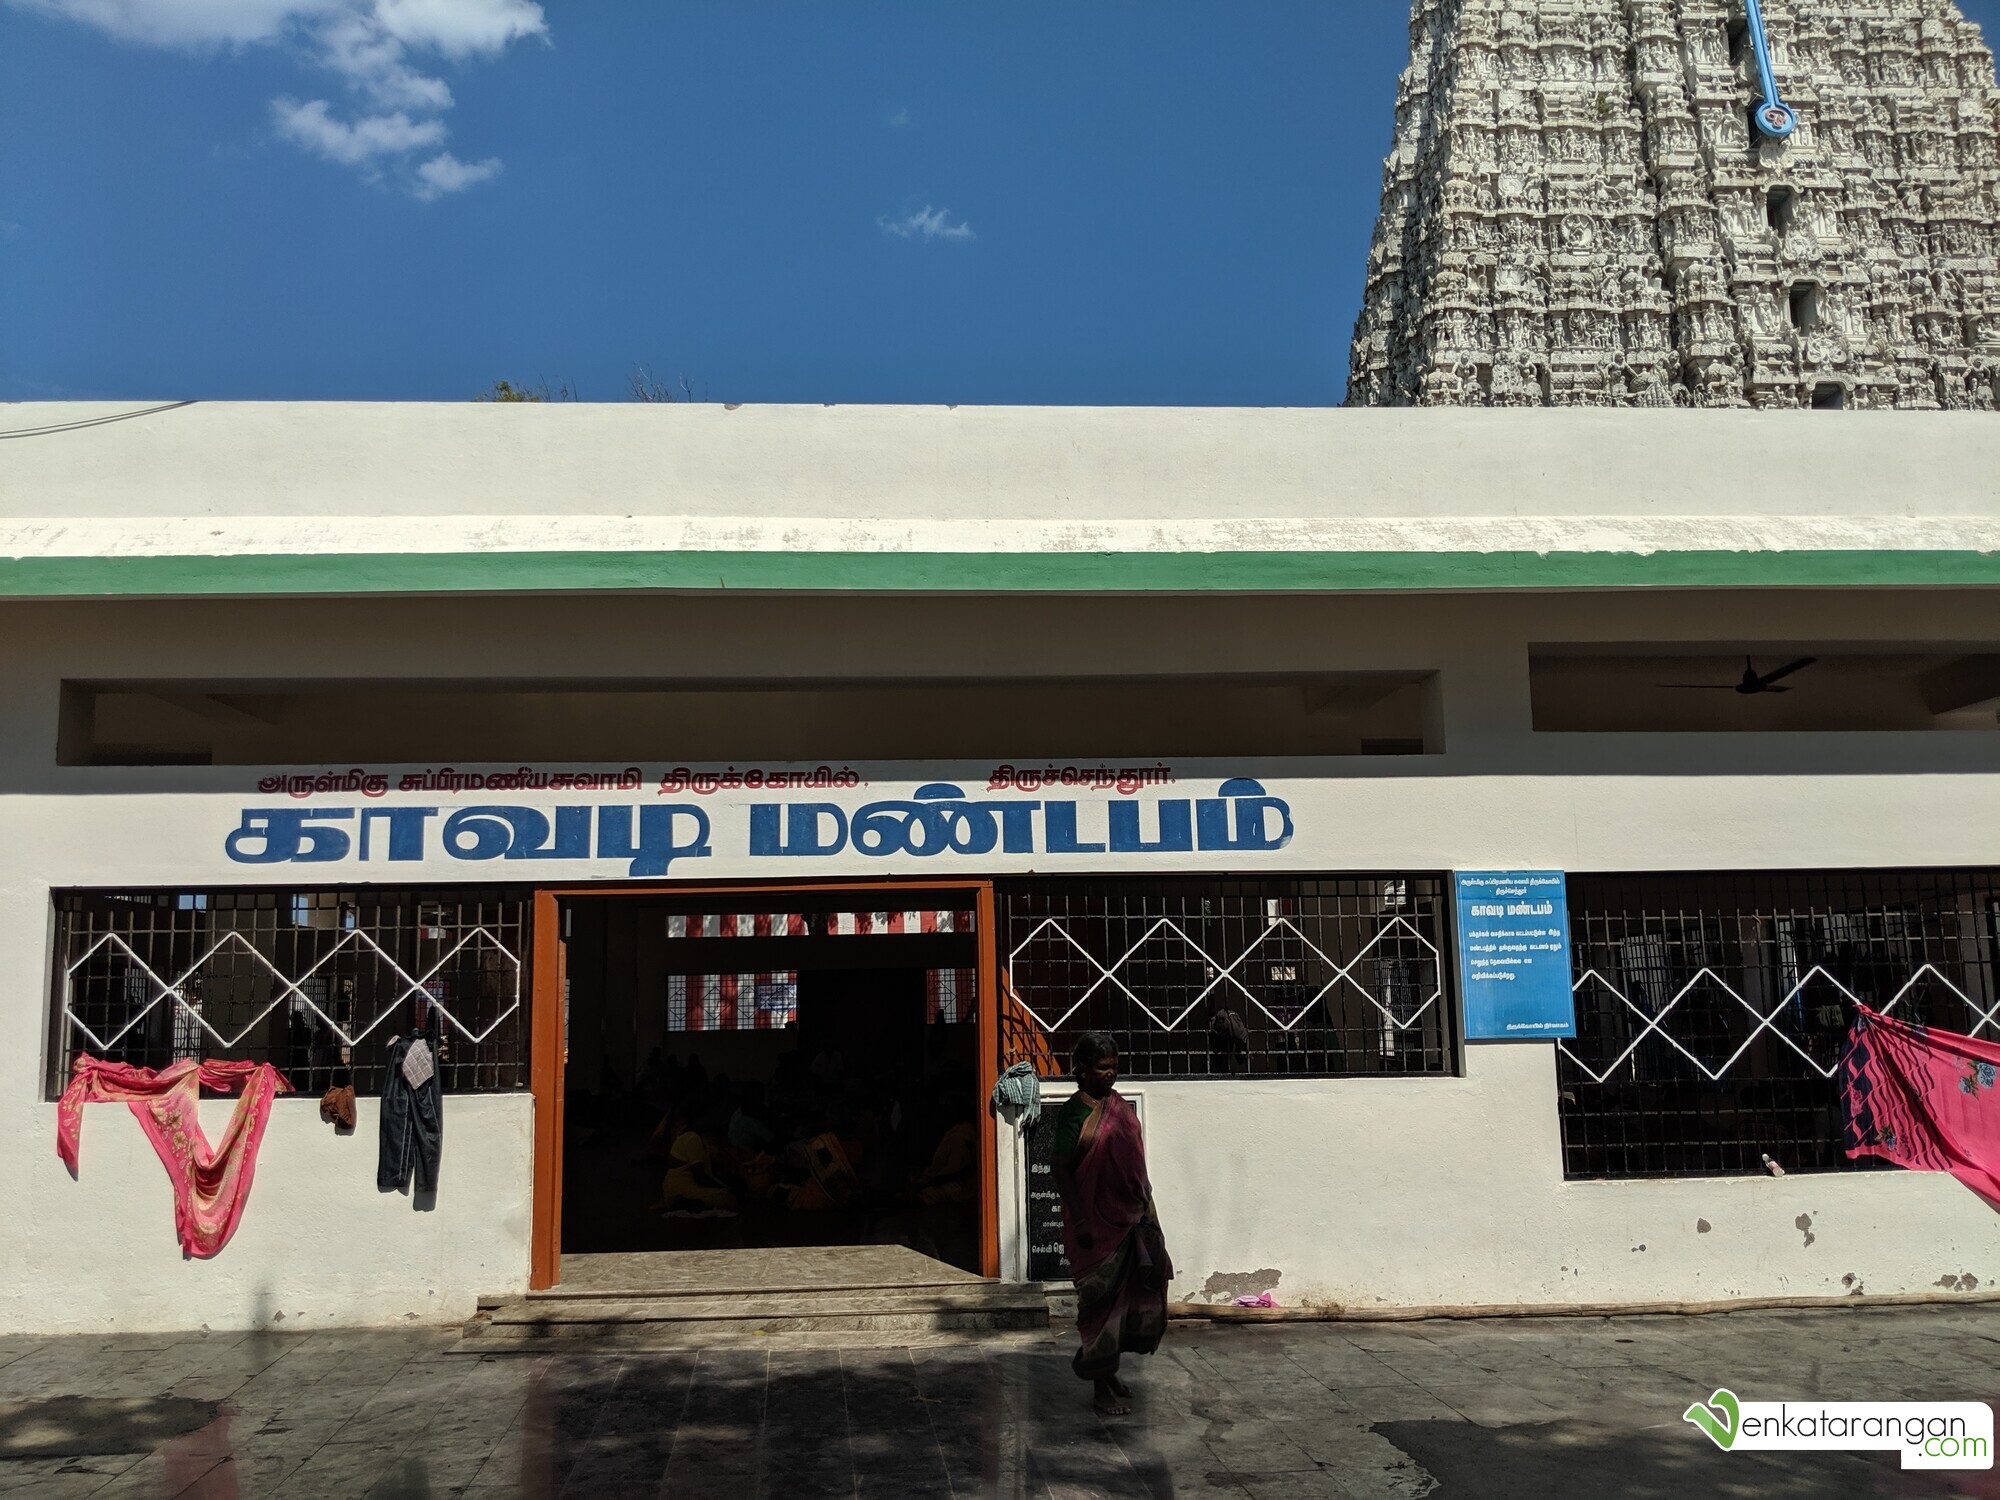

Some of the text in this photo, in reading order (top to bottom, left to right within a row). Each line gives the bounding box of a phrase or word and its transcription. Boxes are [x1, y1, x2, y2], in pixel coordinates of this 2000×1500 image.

[258, 768, 388, 798] அருள்மிகு
[225, 778, 1294, 877] காவடி மண்டபம்
[1471, 900, 1552, 917] காவடி மண்டபம்
